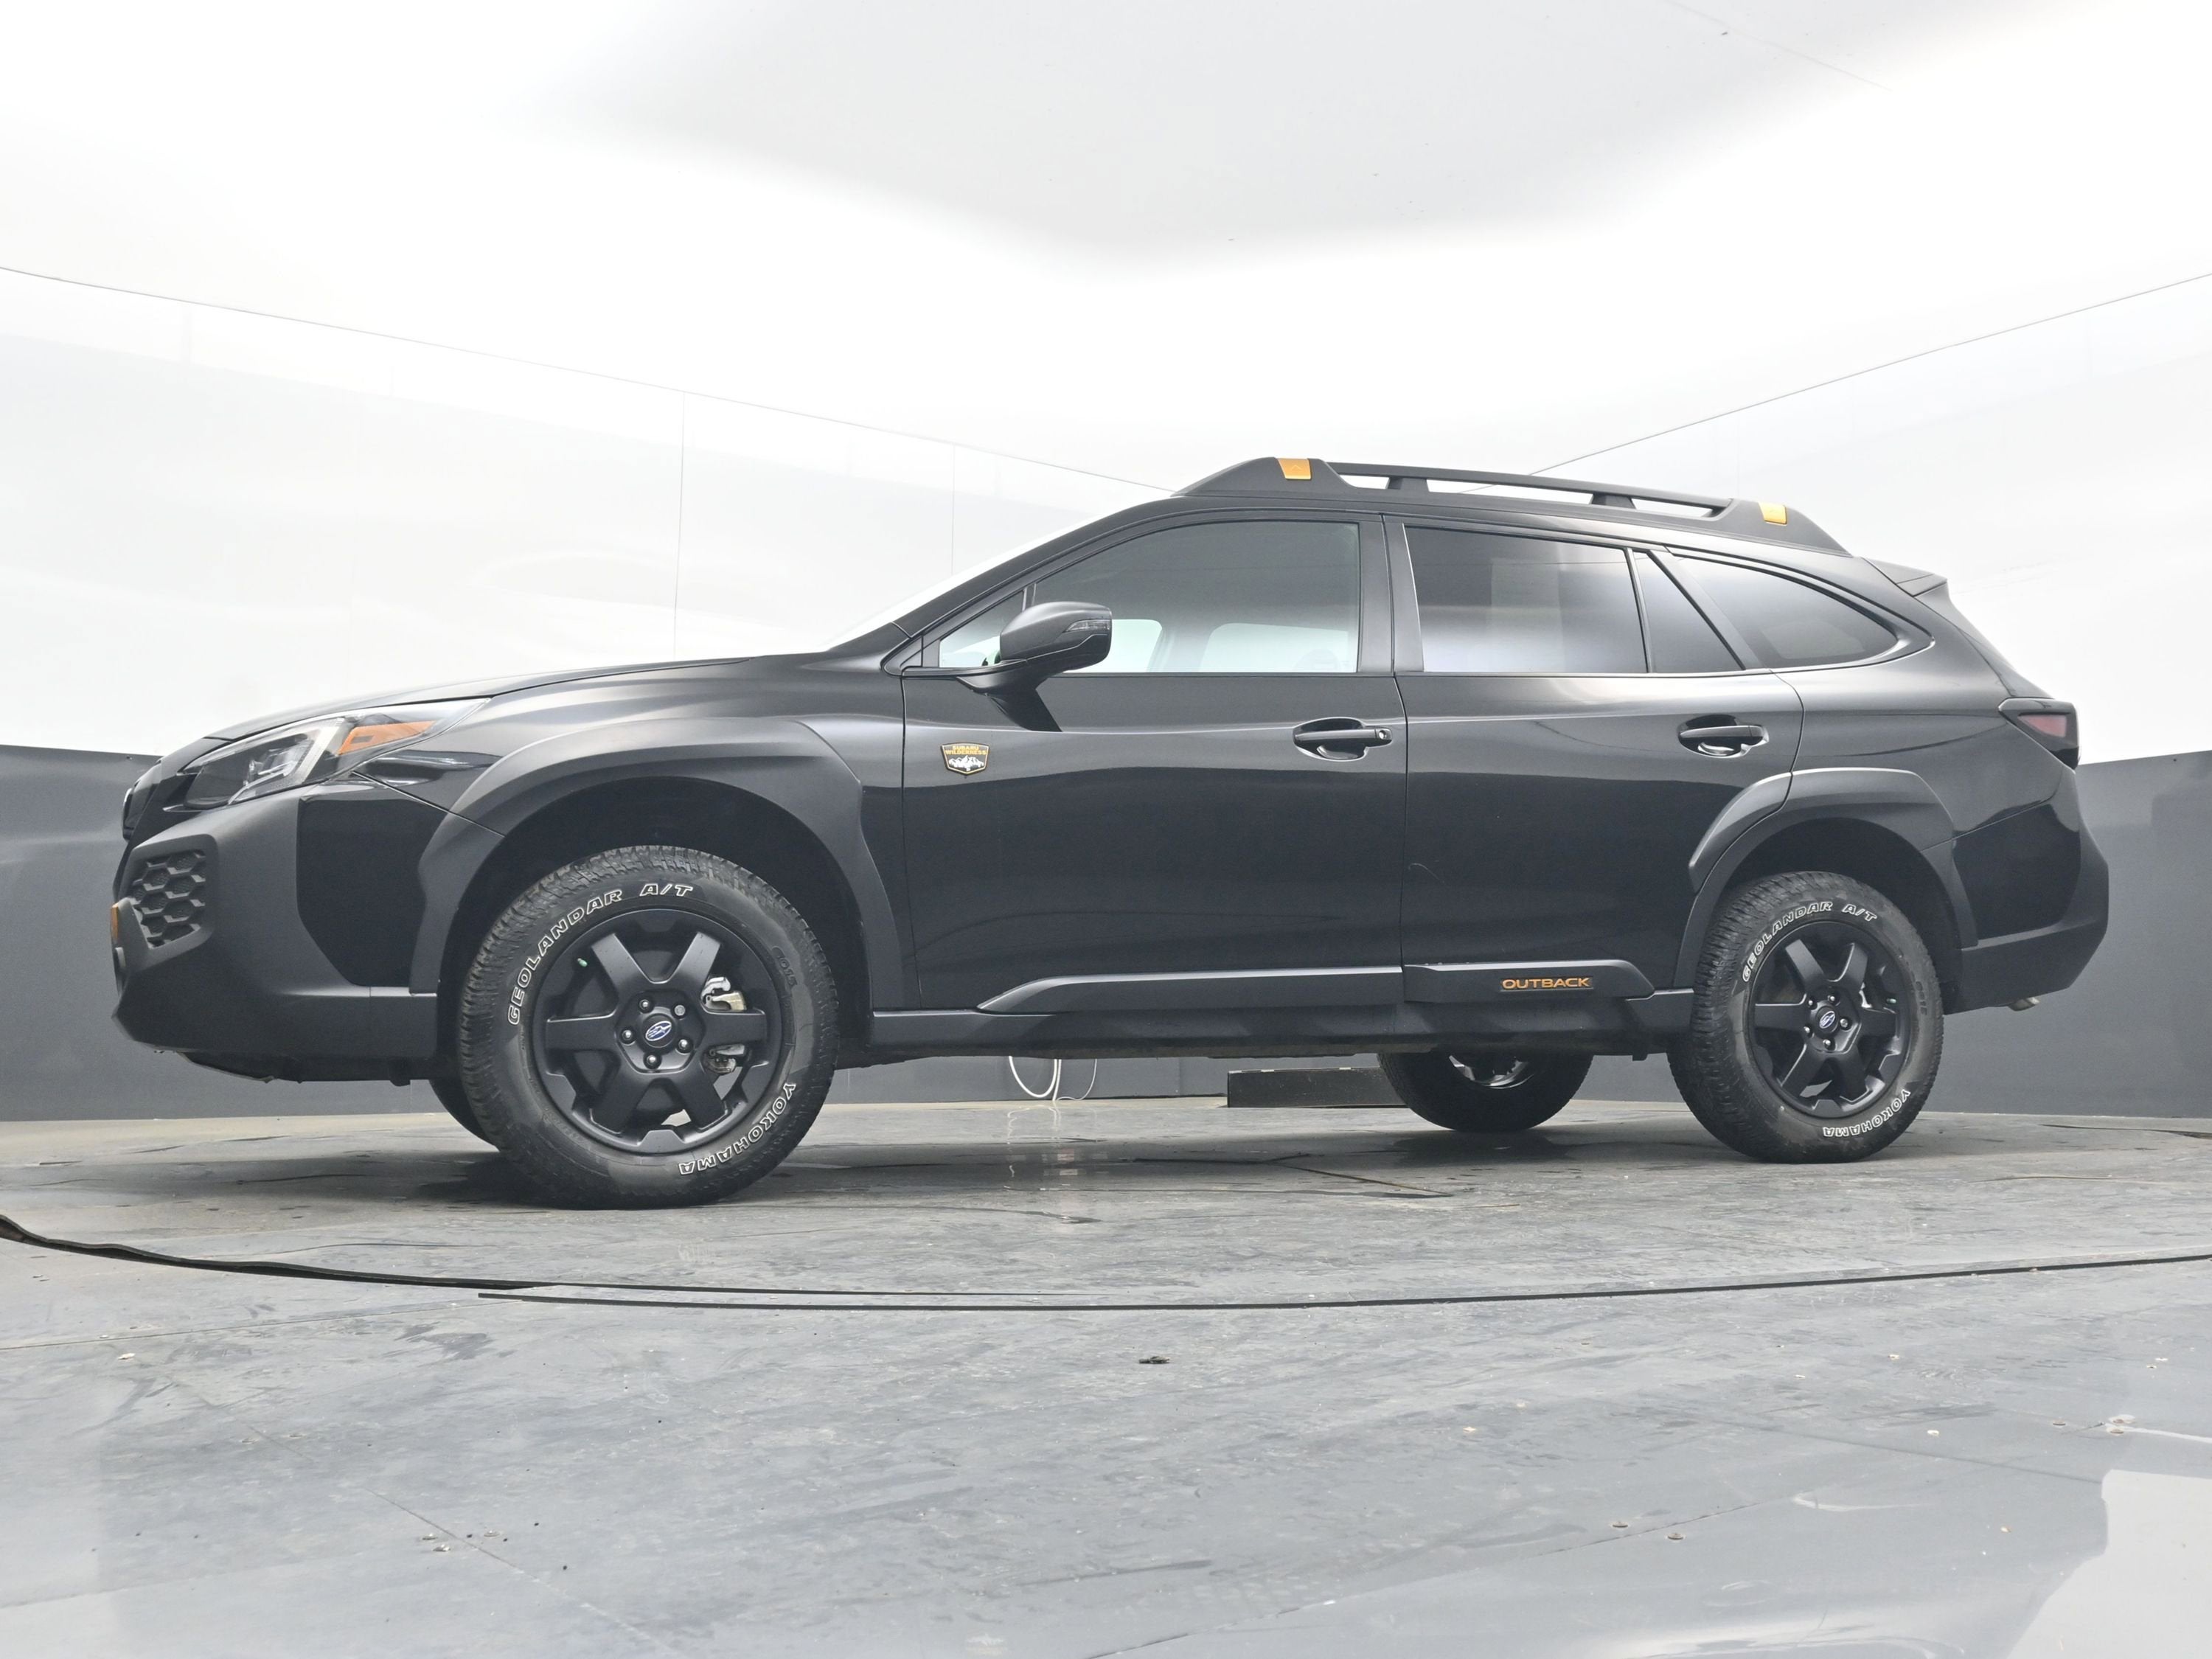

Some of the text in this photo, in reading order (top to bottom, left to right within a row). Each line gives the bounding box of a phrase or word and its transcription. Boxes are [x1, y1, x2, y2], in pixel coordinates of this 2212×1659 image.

[507, 883, 693, 1025] GEOLANDAR A/T
[1742, 901, 1877, 983] GEOLANDAR A/T
[1502, 978, 1590, 990] OUTBACK
[678, 1082, 796, 1175] YOKOHAMA
[1823, 1088, 1911, 1138] YOKOHAMA
